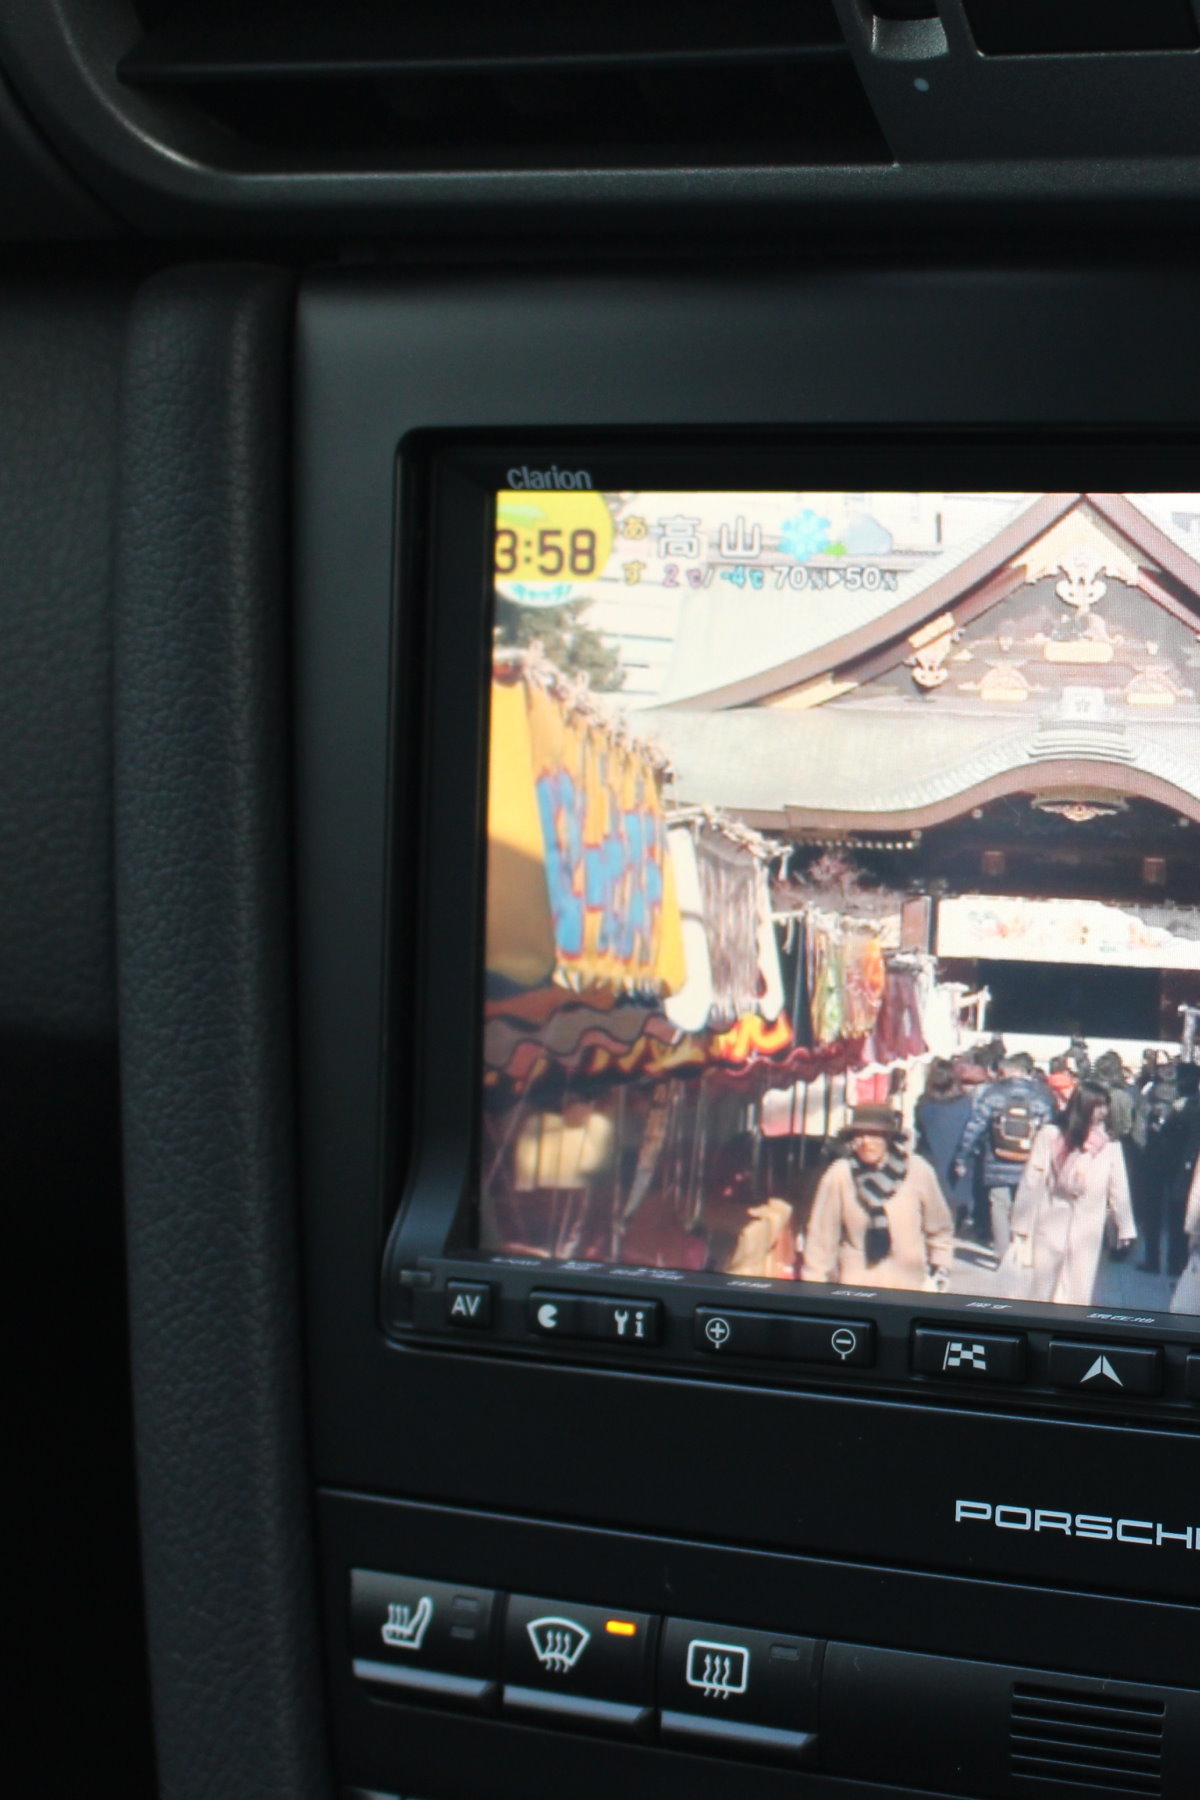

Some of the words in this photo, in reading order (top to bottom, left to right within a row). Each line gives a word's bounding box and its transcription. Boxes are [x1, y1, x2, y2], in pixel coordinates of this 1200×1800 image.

[507, 466, 592, 490] Clarion
[496, 529, 597, 576] 3:58
[657, 514, 762, 559] 高山
[451, 1295, 480, 1317] AV
